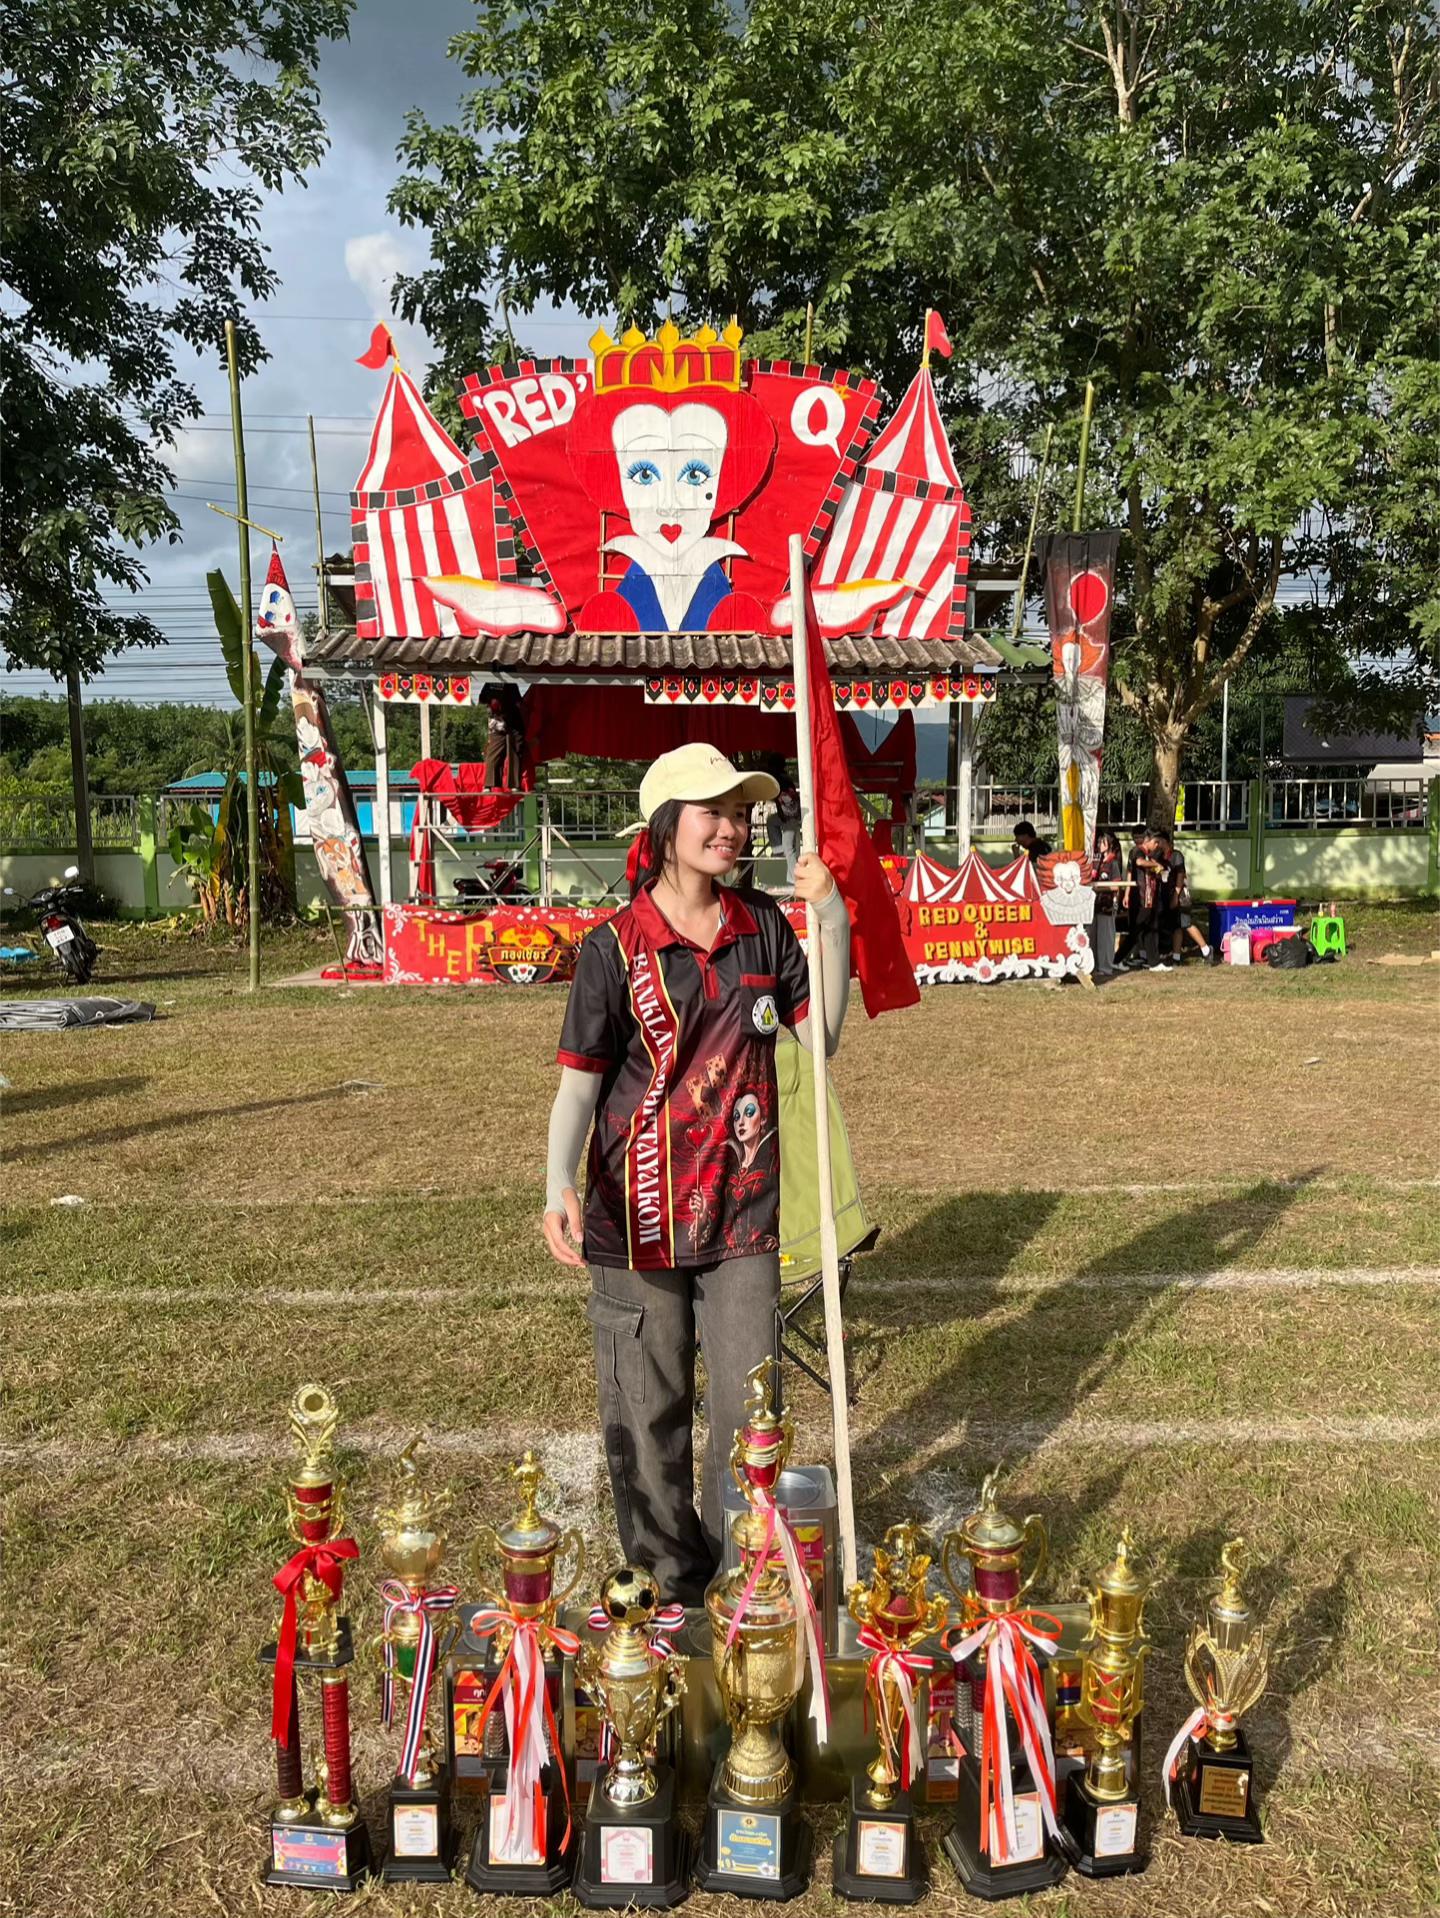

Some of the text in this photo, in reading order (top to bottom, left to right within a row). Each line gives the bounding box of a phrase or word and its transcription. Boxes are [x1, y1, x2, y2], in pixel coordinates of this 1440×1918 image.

[790, 386, 846, 459] Q
[919, 904, 1032, 927] RED QUEEN
[974, 921, 989, 939] &
[411, 917, 463, 976] THE
[924, 937, 1036, 960] PENNYWISE
